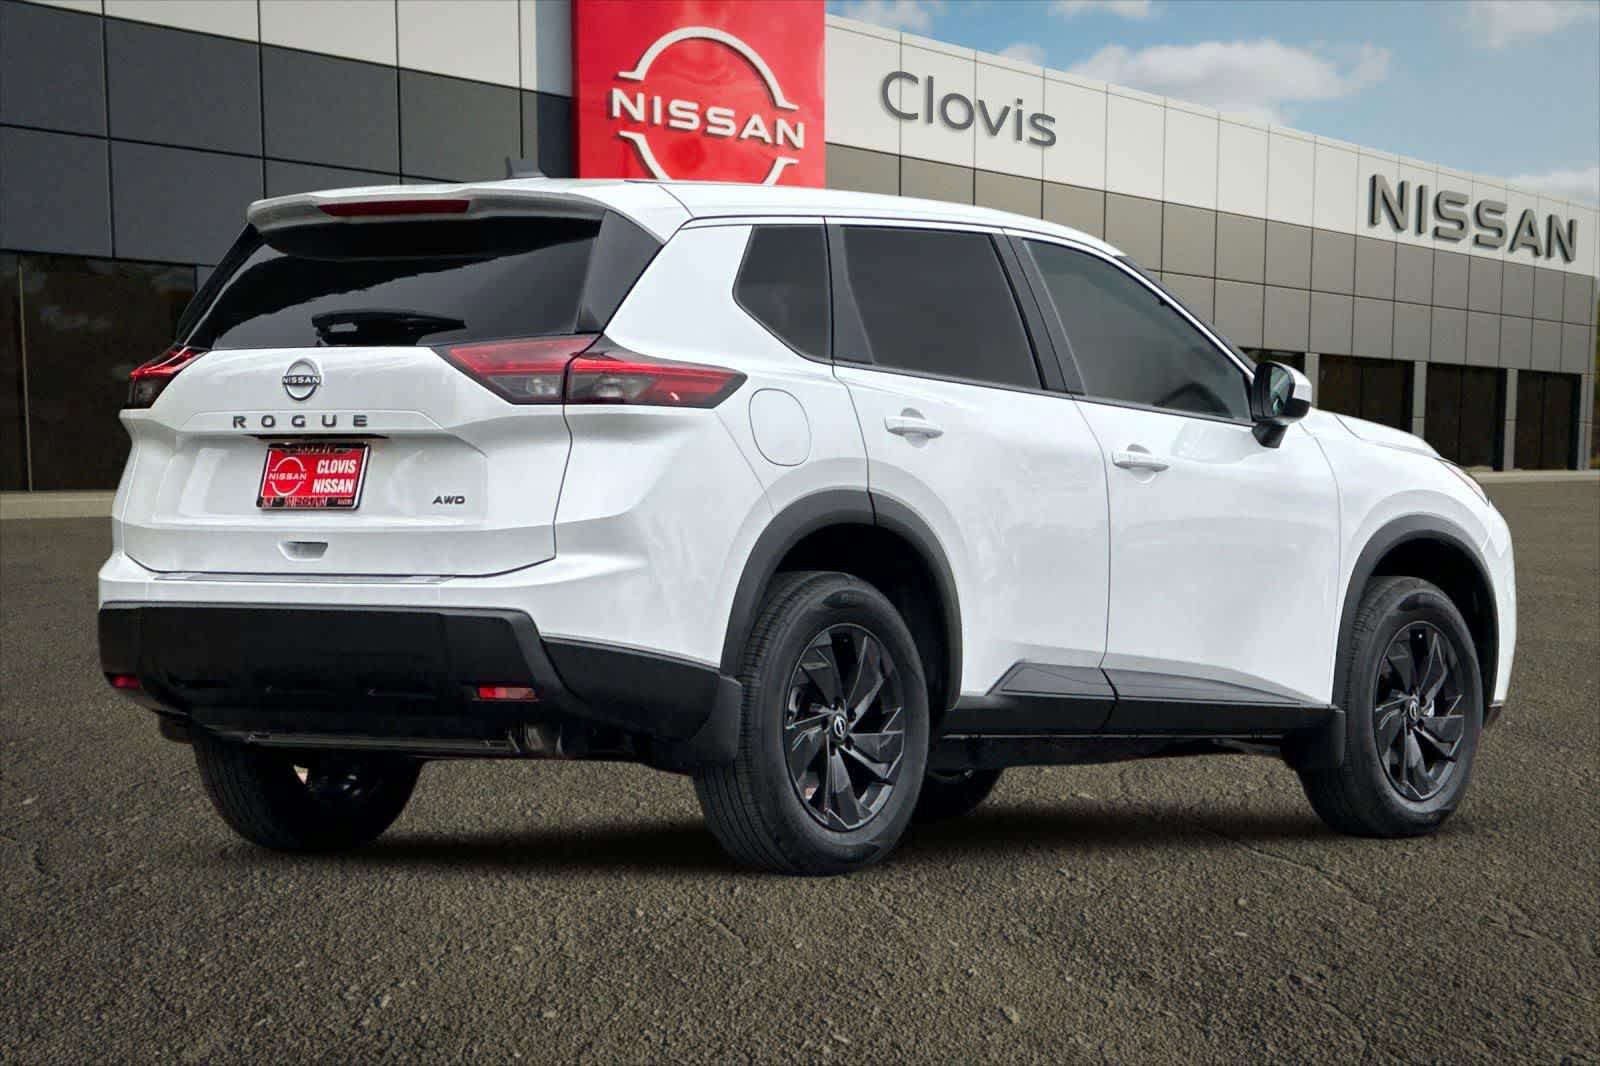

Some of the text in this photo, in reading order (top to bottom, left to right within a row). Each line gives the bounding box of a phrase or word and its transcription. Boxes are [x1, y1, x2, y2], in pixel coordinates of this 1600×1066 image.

[880, 70, 1057, 148] Clovis
[610, 86, 806, 150] NISSAN
[1369, 173, 1577, 263] NISSAN
[282, 375, 320, 385] NISSAN
[232, 414, 369, 429] ROGUE
[317, 459, 357, 474] CLOVIS
[268, 472, 307, 481] NISSAN
[312, 478, 355, 493] NISSAN
[432, 495, 465, 505] AWD
